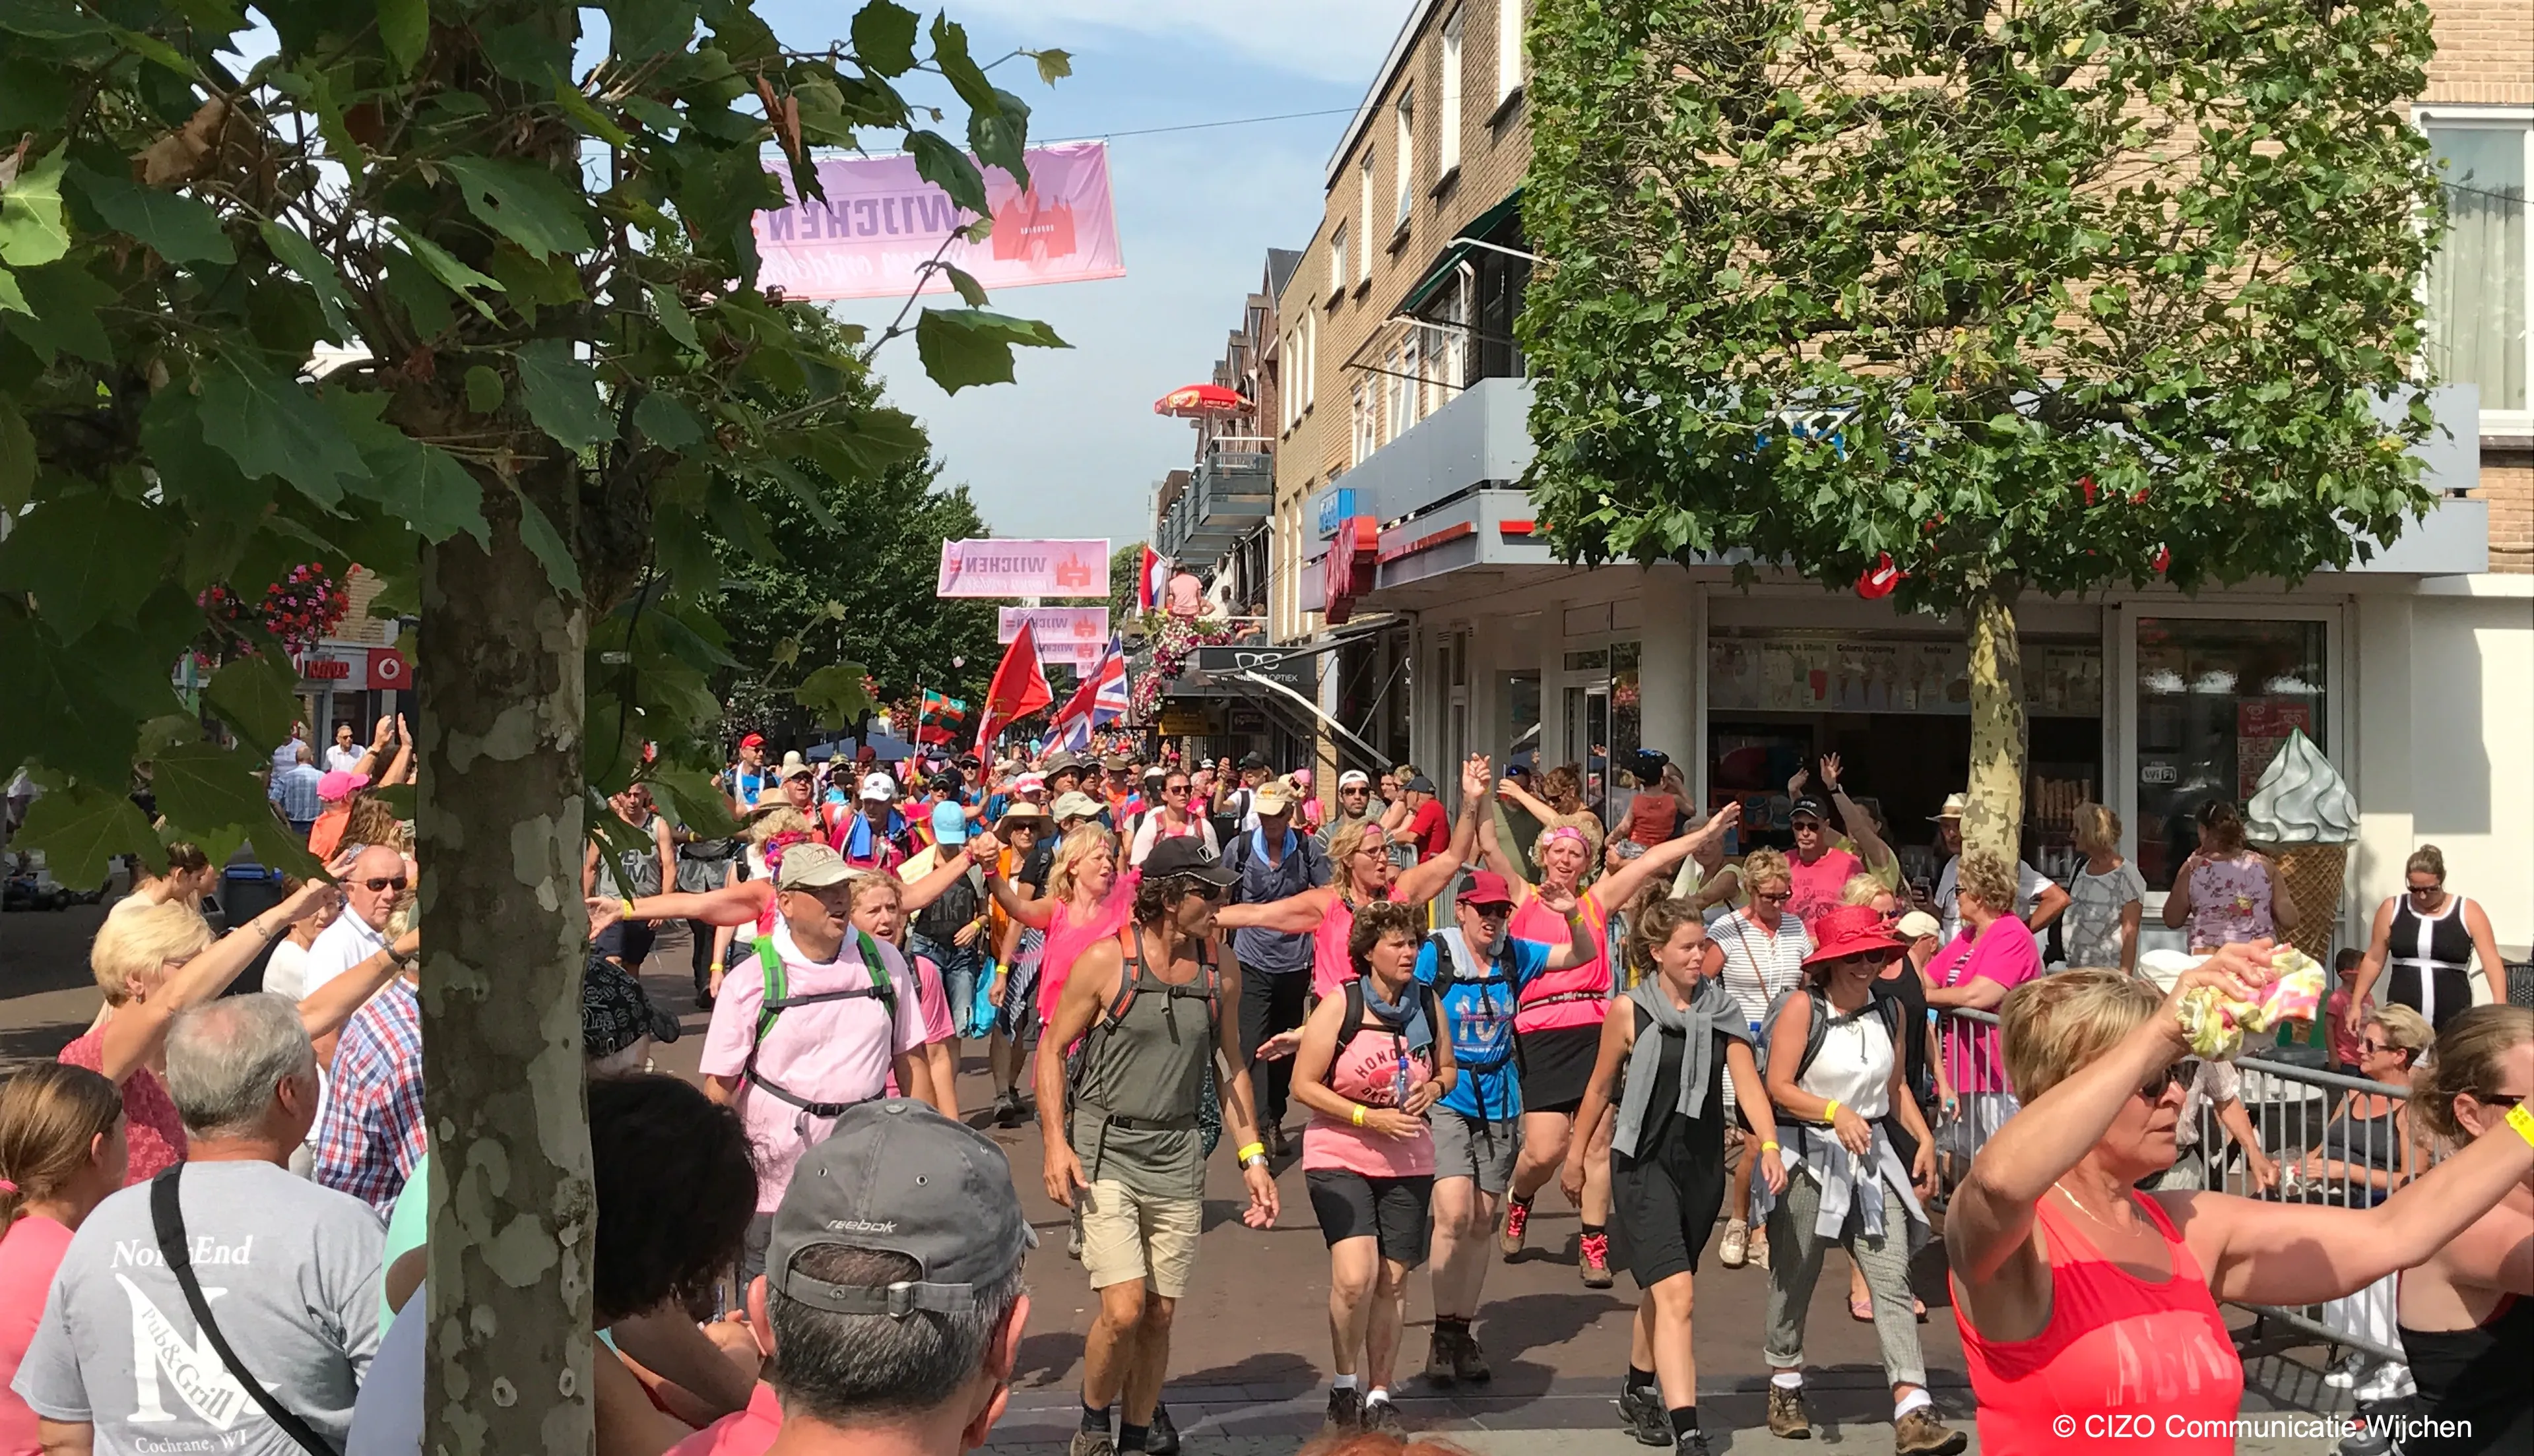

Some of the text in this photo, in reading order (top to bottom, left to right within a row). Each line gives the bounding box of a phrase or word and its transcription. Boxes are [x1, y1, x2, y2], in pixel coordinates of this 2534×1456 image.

[1269, 674, 1298, 682] OPTIEK
[826, 1219, 898, 1233] reebok
[135, 1429, 247, 1454] Cochrane, WI
